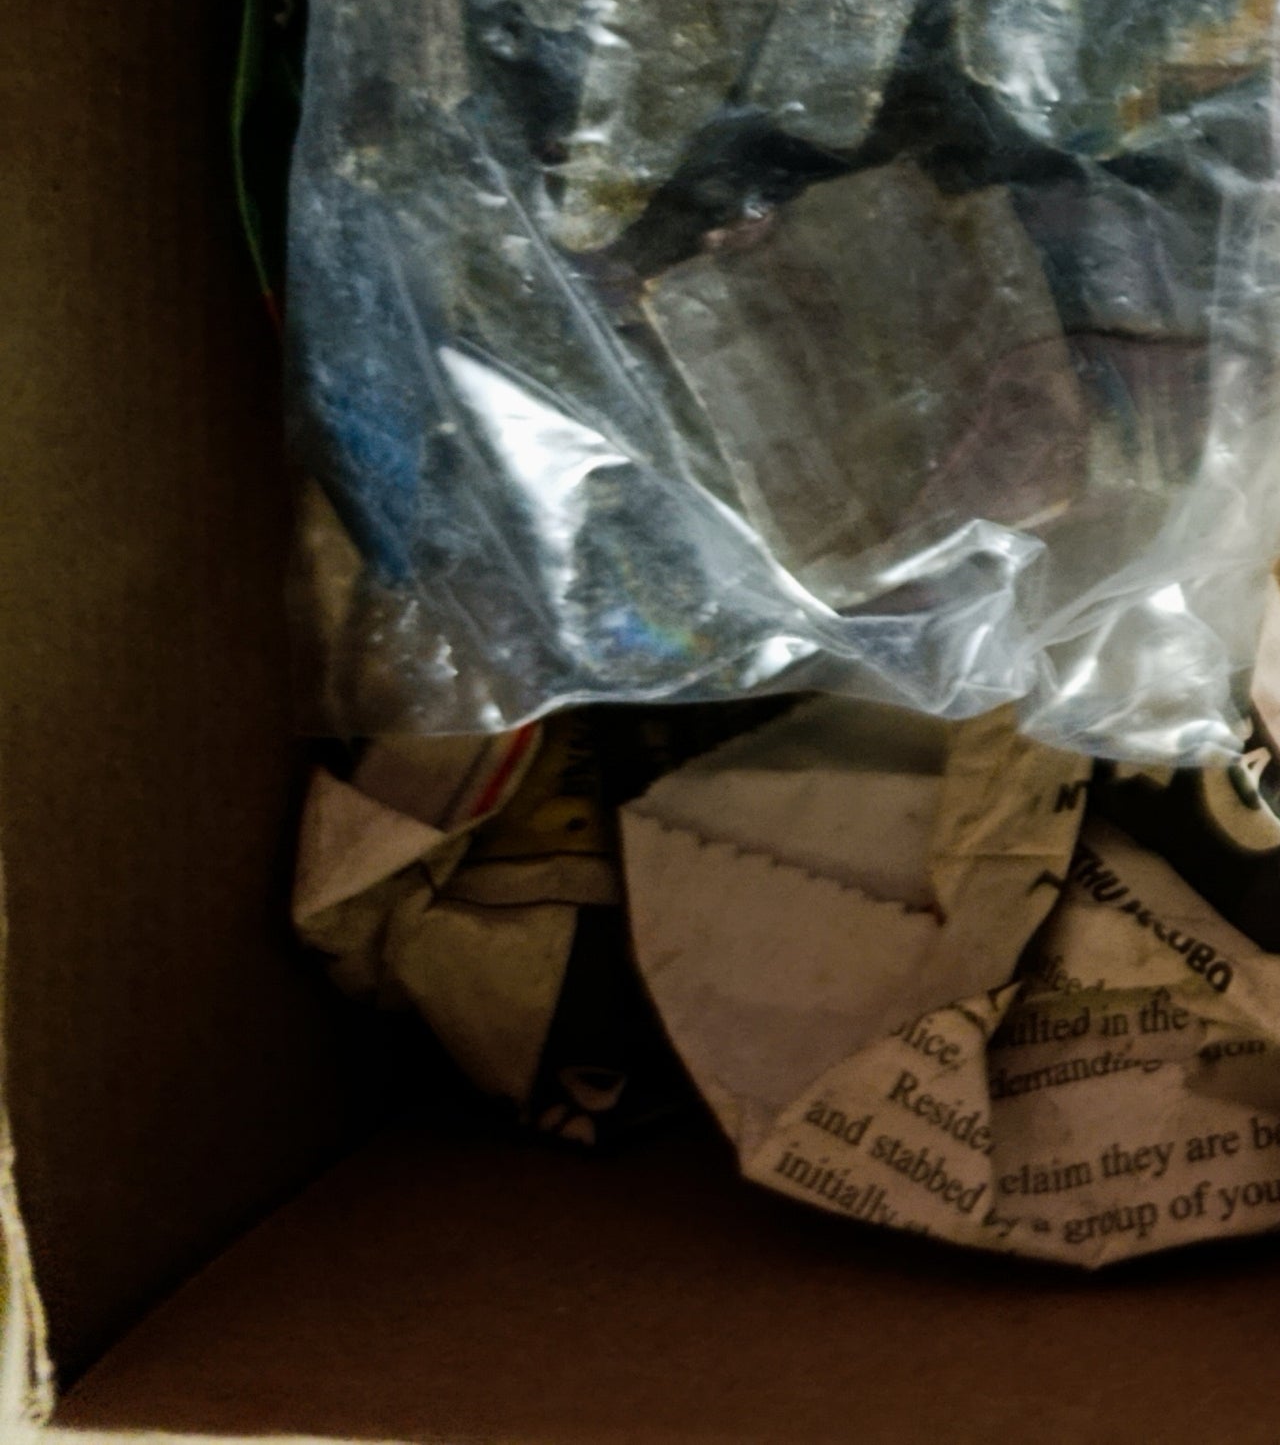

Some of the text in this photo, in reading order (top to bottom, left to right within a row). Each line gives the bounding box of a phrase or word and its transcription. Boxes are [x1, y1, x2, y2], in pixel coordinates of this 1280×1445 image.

[1138, 996, 1190, 1035] the
[887, 1070, 997, 1157] Reside
[803, 1100, 874, 1147] and
[866, 1131, 987, 1215] stabbed
[1064, 1199, 1160, 1245] group
[1168, 1180, 1211, 1220] of
[1000, 1159, 1093, 1197] claim
[1101, 1139, 1176, 1179] they
[1186, 1129, 1240, 1163] are
